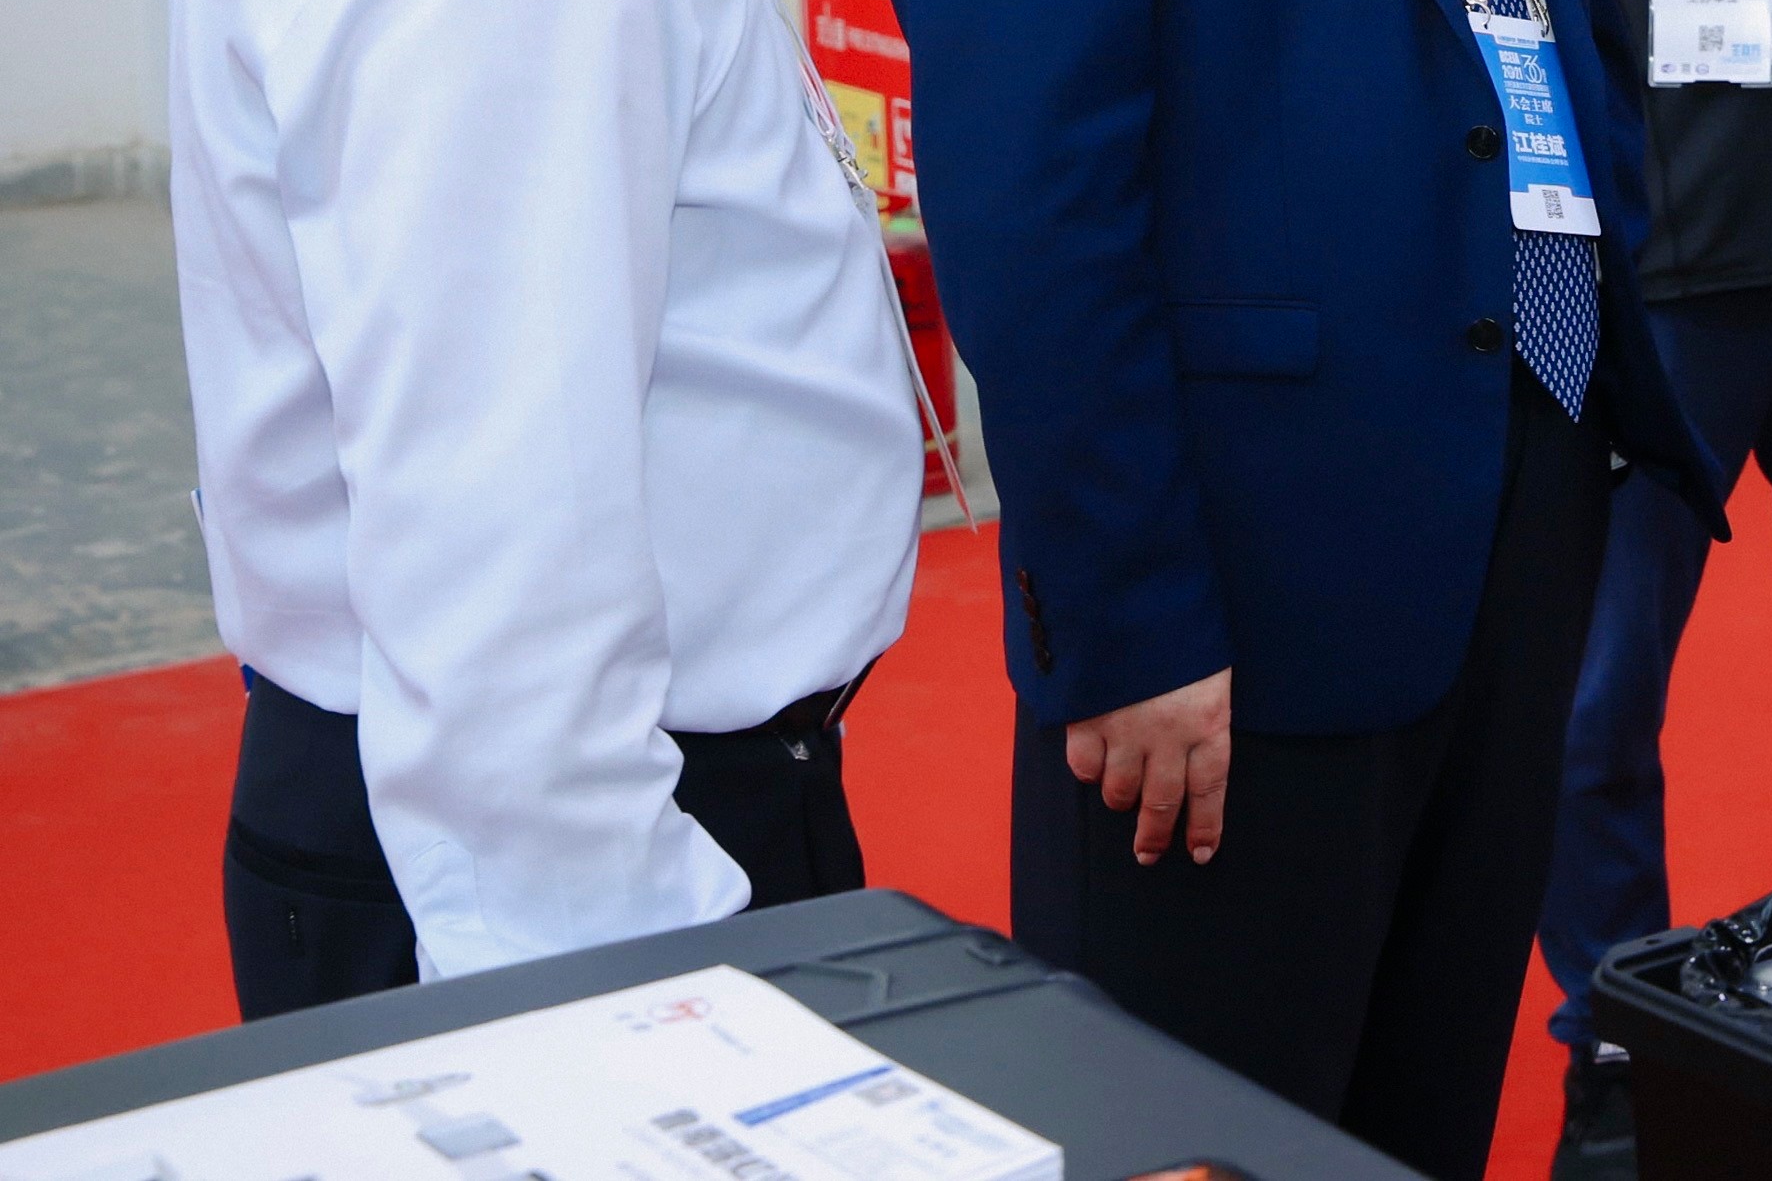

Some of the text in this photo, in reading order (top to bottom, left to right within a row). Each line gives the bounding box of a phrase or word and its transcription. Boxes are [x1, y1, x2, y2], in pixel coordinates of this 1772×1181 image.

[1509, 95, 1553, 113] 大会主席
[1512, 130, 1567, 158] 江桂斌
